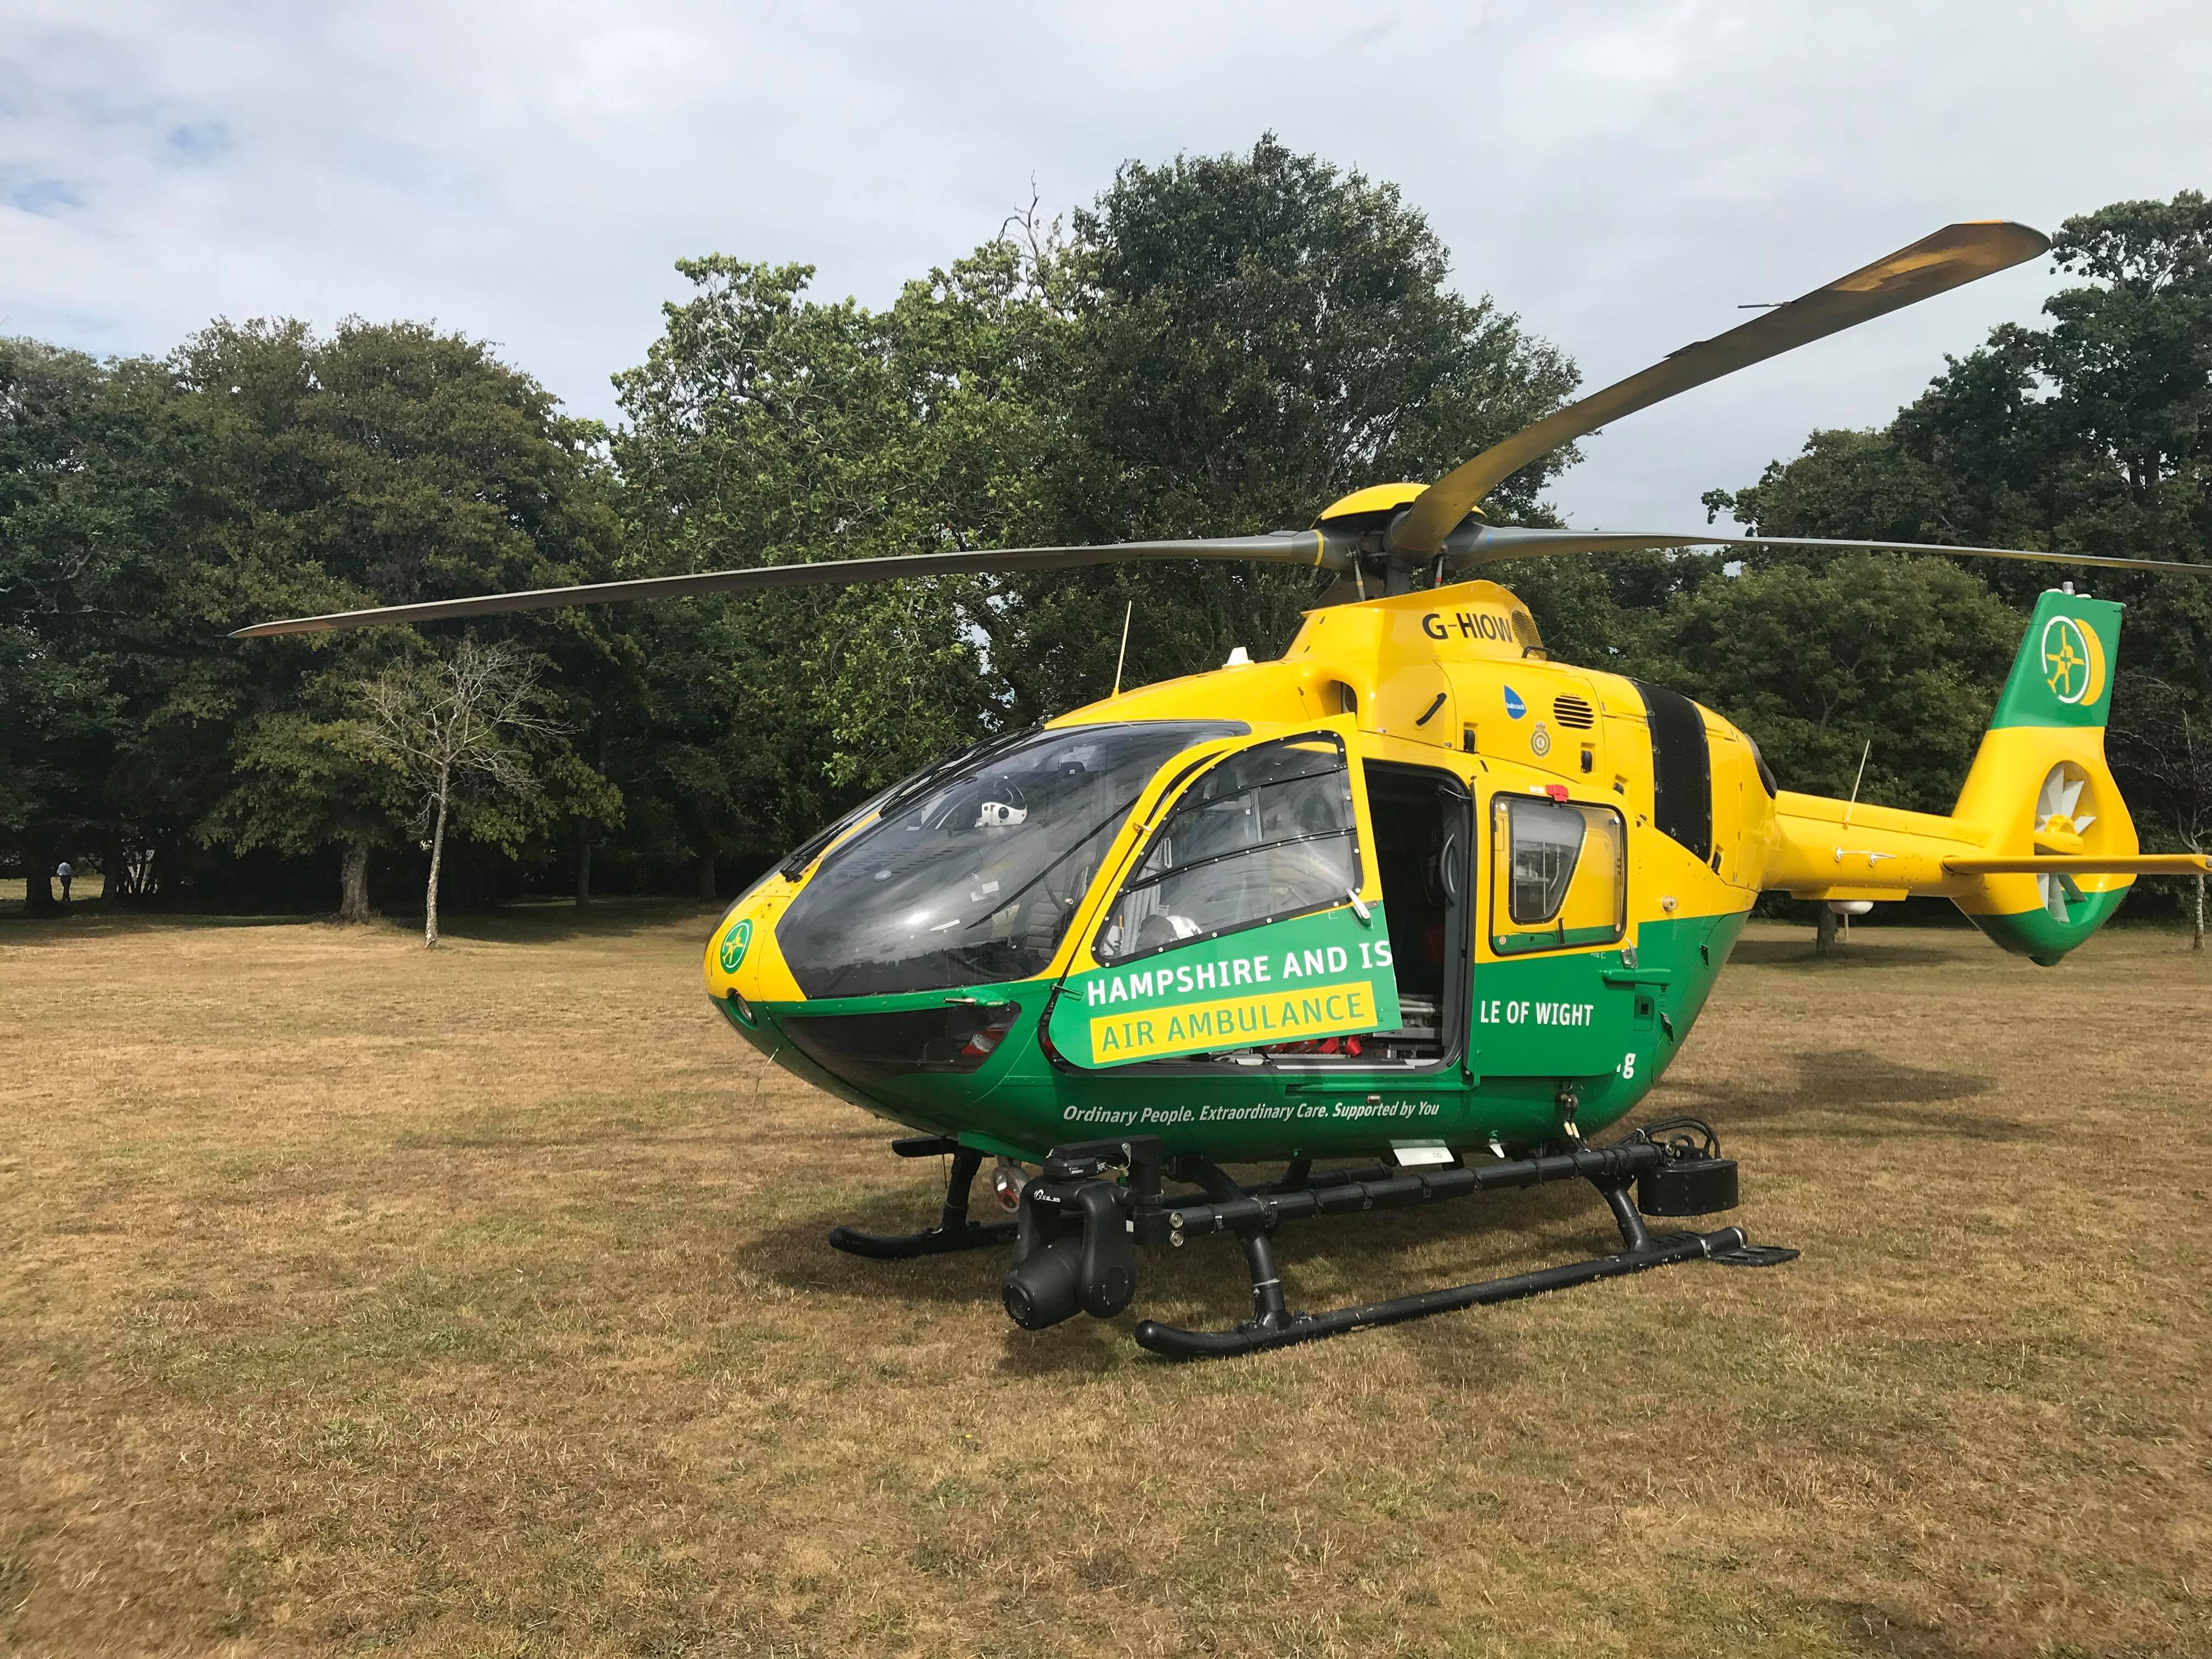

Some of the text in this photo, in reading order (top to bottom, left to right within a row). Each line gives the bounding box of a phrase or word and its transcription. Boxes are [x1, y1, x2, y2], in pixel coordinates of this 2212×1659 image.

[1422, 613, 1513, 643] G-HIOW
[1088, 940, 1393, 1006] HAMPSHIRE AND IS
[1102, 992, 1364, 1052] AIR AMBULANCE
[1481, 1000, 1594, 1026] LE OF WIGHT
[1063, 1101, 1440, 1126] Ordinary People. Extraordinary Care. Supported by You
